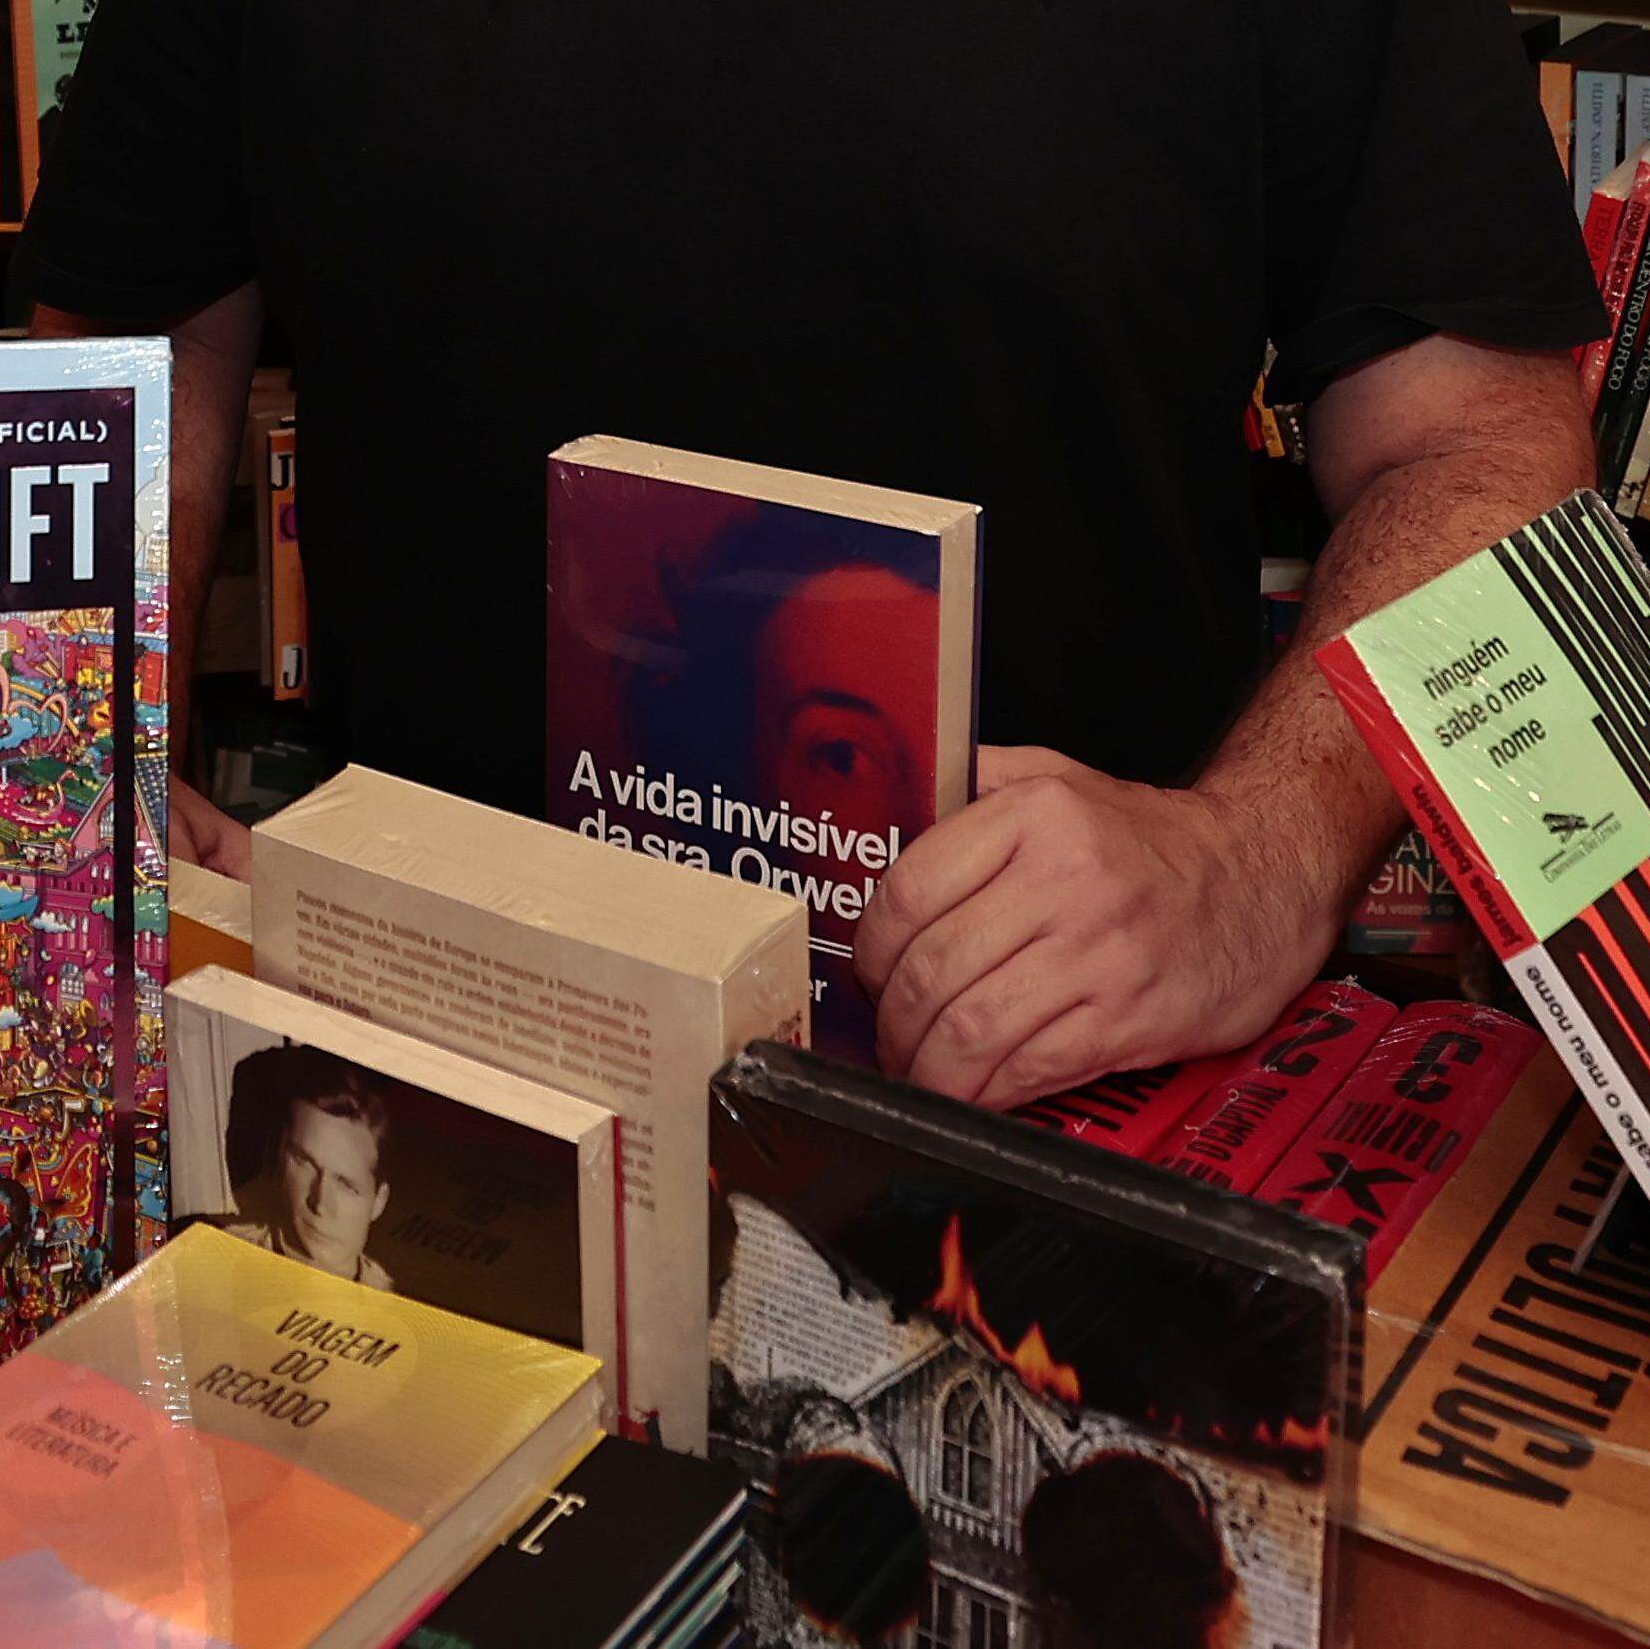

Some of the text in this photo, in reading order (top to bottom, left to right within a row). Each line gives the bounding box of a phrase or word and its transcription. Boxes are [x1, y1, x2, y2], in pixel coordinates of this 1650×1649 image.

[1617, 323, 1639, 349] DO
[1605, 348, 1631, 392] FOGO
[1422, 630, 1510, 702] ninguém
[1433, 701, 1488, 749] sabe
[1501, 661, 1547, 703] meu
[1487, 716, 1547, 770] nome
[569, 750, 901, 871] A vida invisível
[1412, 782, 1523, 949] james baldwin
[1525, 963, 1573, 1032] nome
[1569, 1033, 1611, 1090] meu
[270, 1349, 330, 1384] DO
[273, 1308, 401, 1371] VIAGEM
[196, 1363, 331, 1429] RECADO
[5, 1425, 118, 1478] LITERATURA
